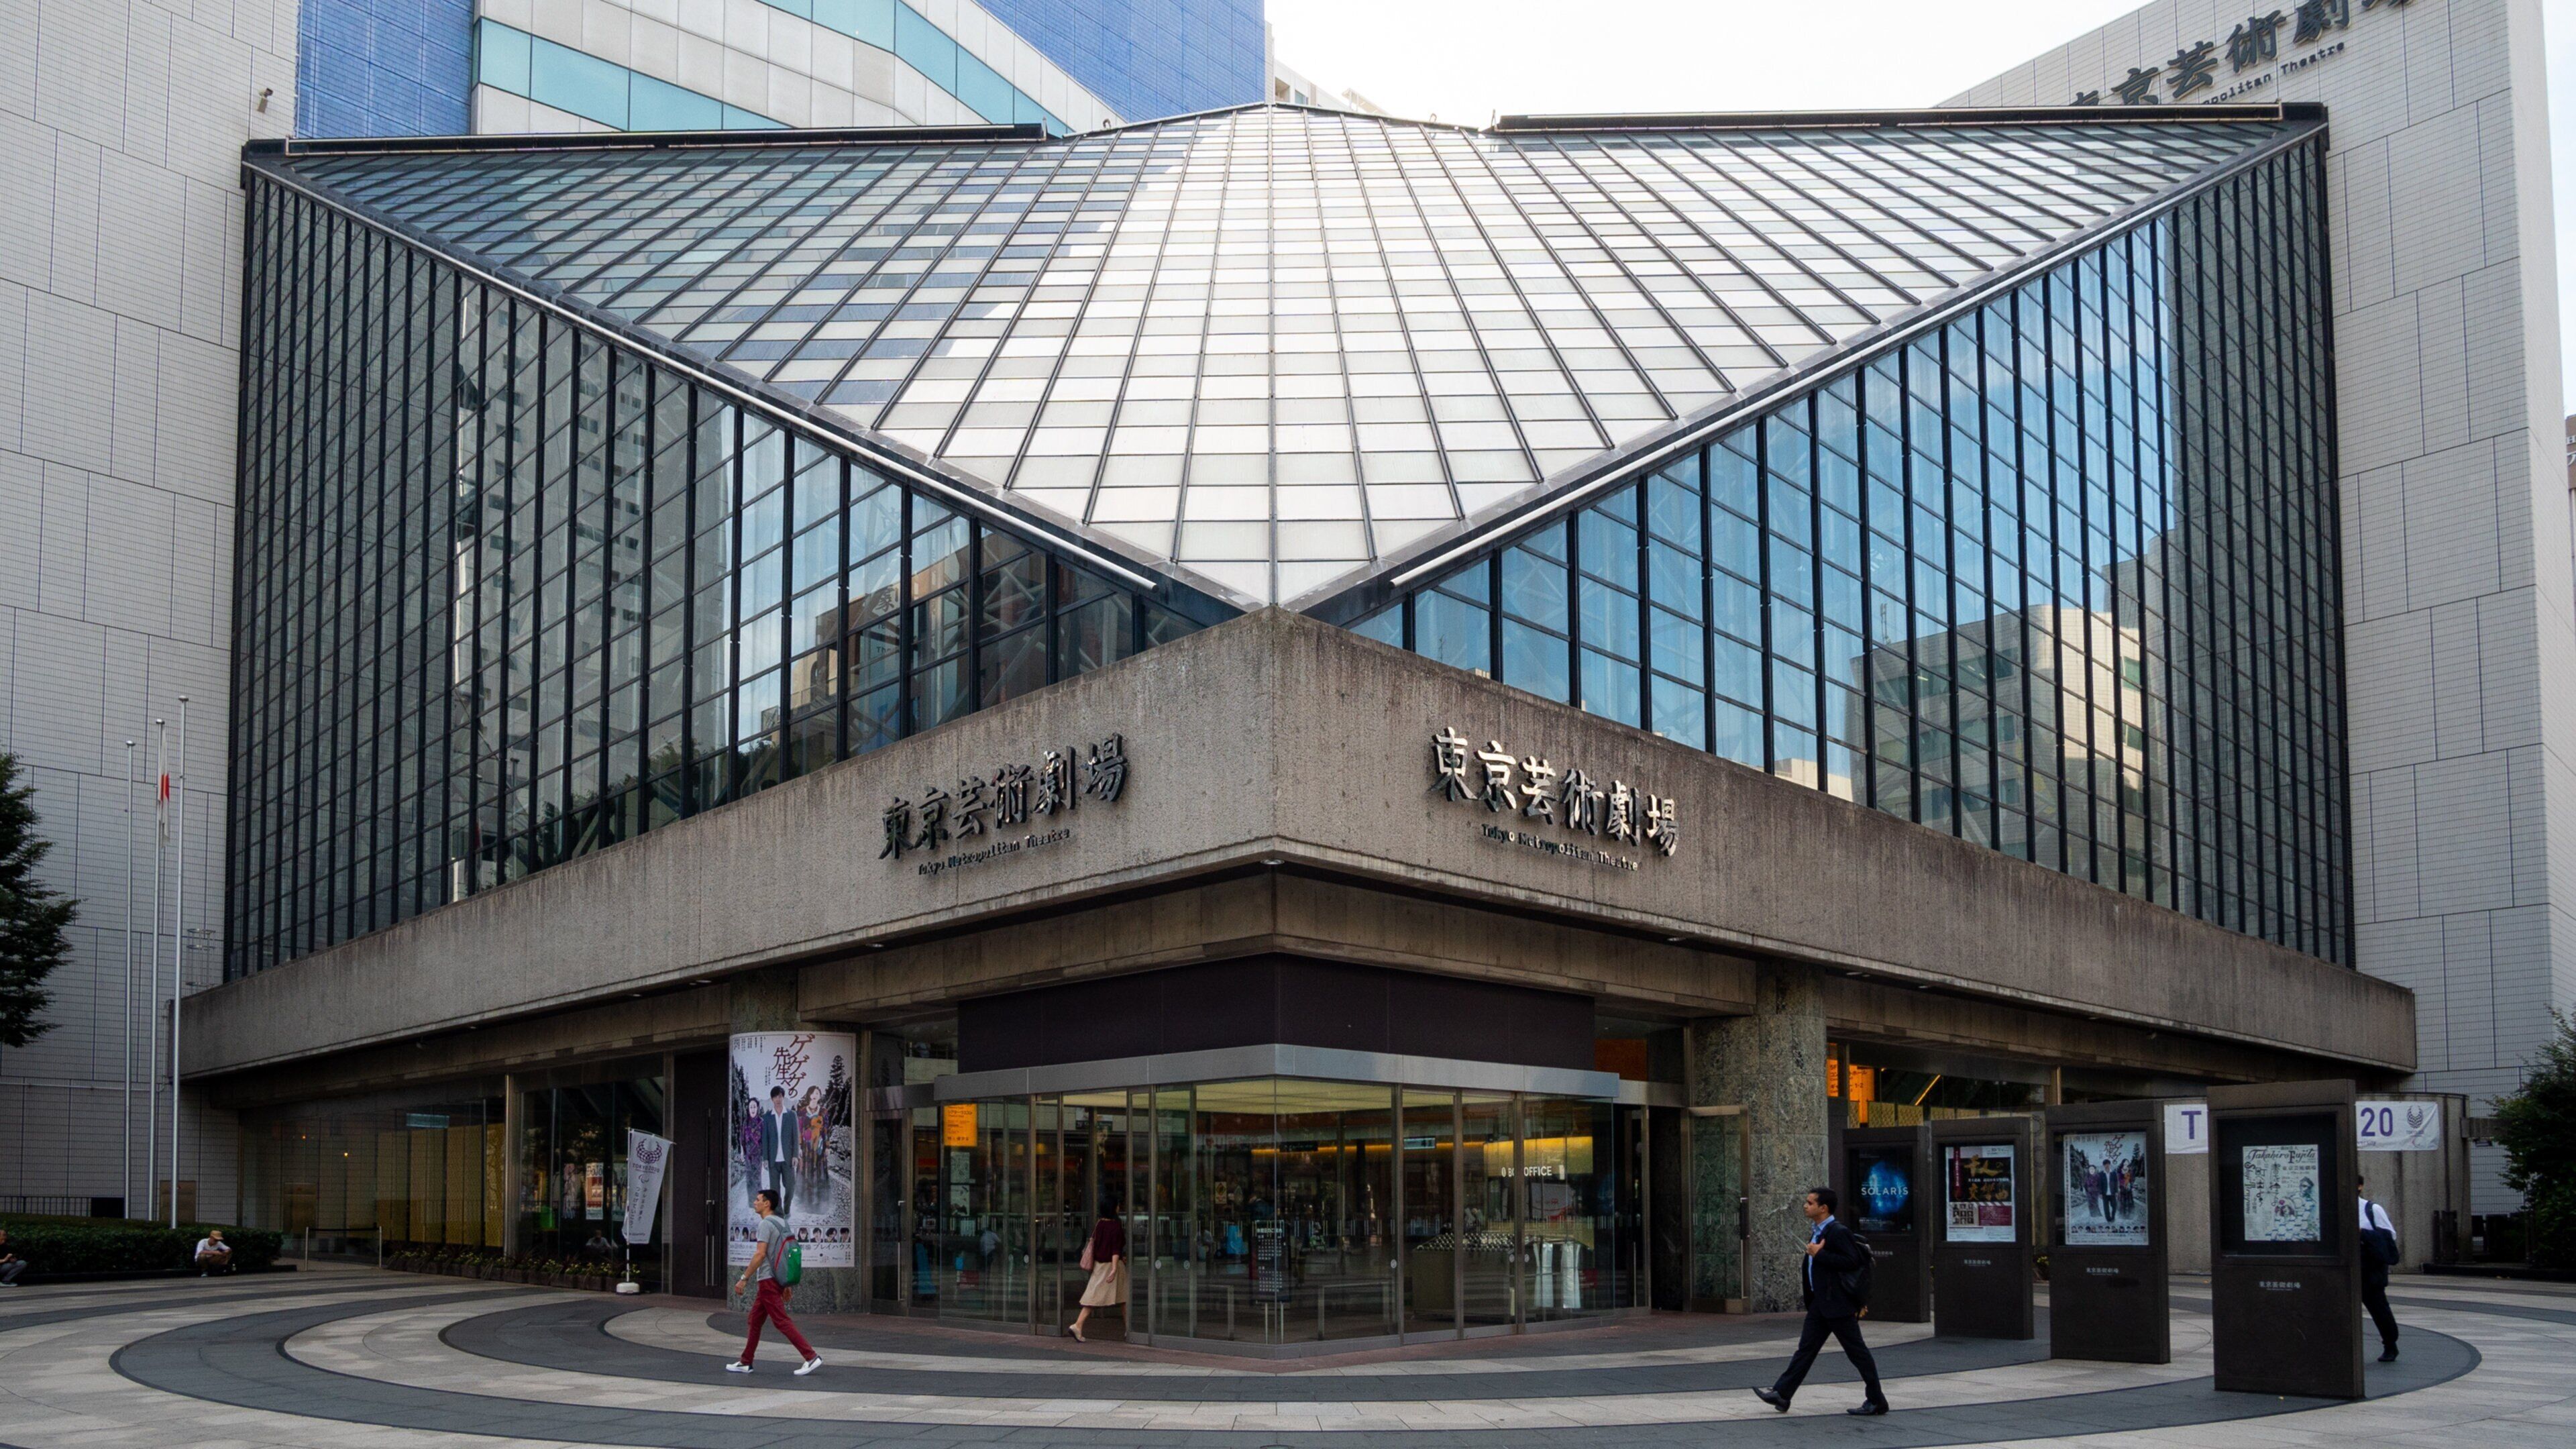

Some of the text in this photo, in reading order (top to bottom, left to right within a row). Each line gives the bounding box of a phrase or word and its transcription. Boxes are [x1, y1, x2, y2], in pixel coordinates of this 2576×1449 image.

[2281, 41, 2345, 76] Theatre
[878, 732, 1128, 859] 東京芸術劇場
[1429, 727, 1680, 857] 東京芸術劇場
[918, 828, 1070, 875] Tokyo Metropolitan Theatre
[1482, 824, 1639, 871] Tokyo Metropolitan Theatre
[1523, 1166, 1552, 1177] OFFICE
[2248, 1146, 2316, 1164] Takahiro Fujita
[1861, 1187, 1909, 1196] SOLARIS
